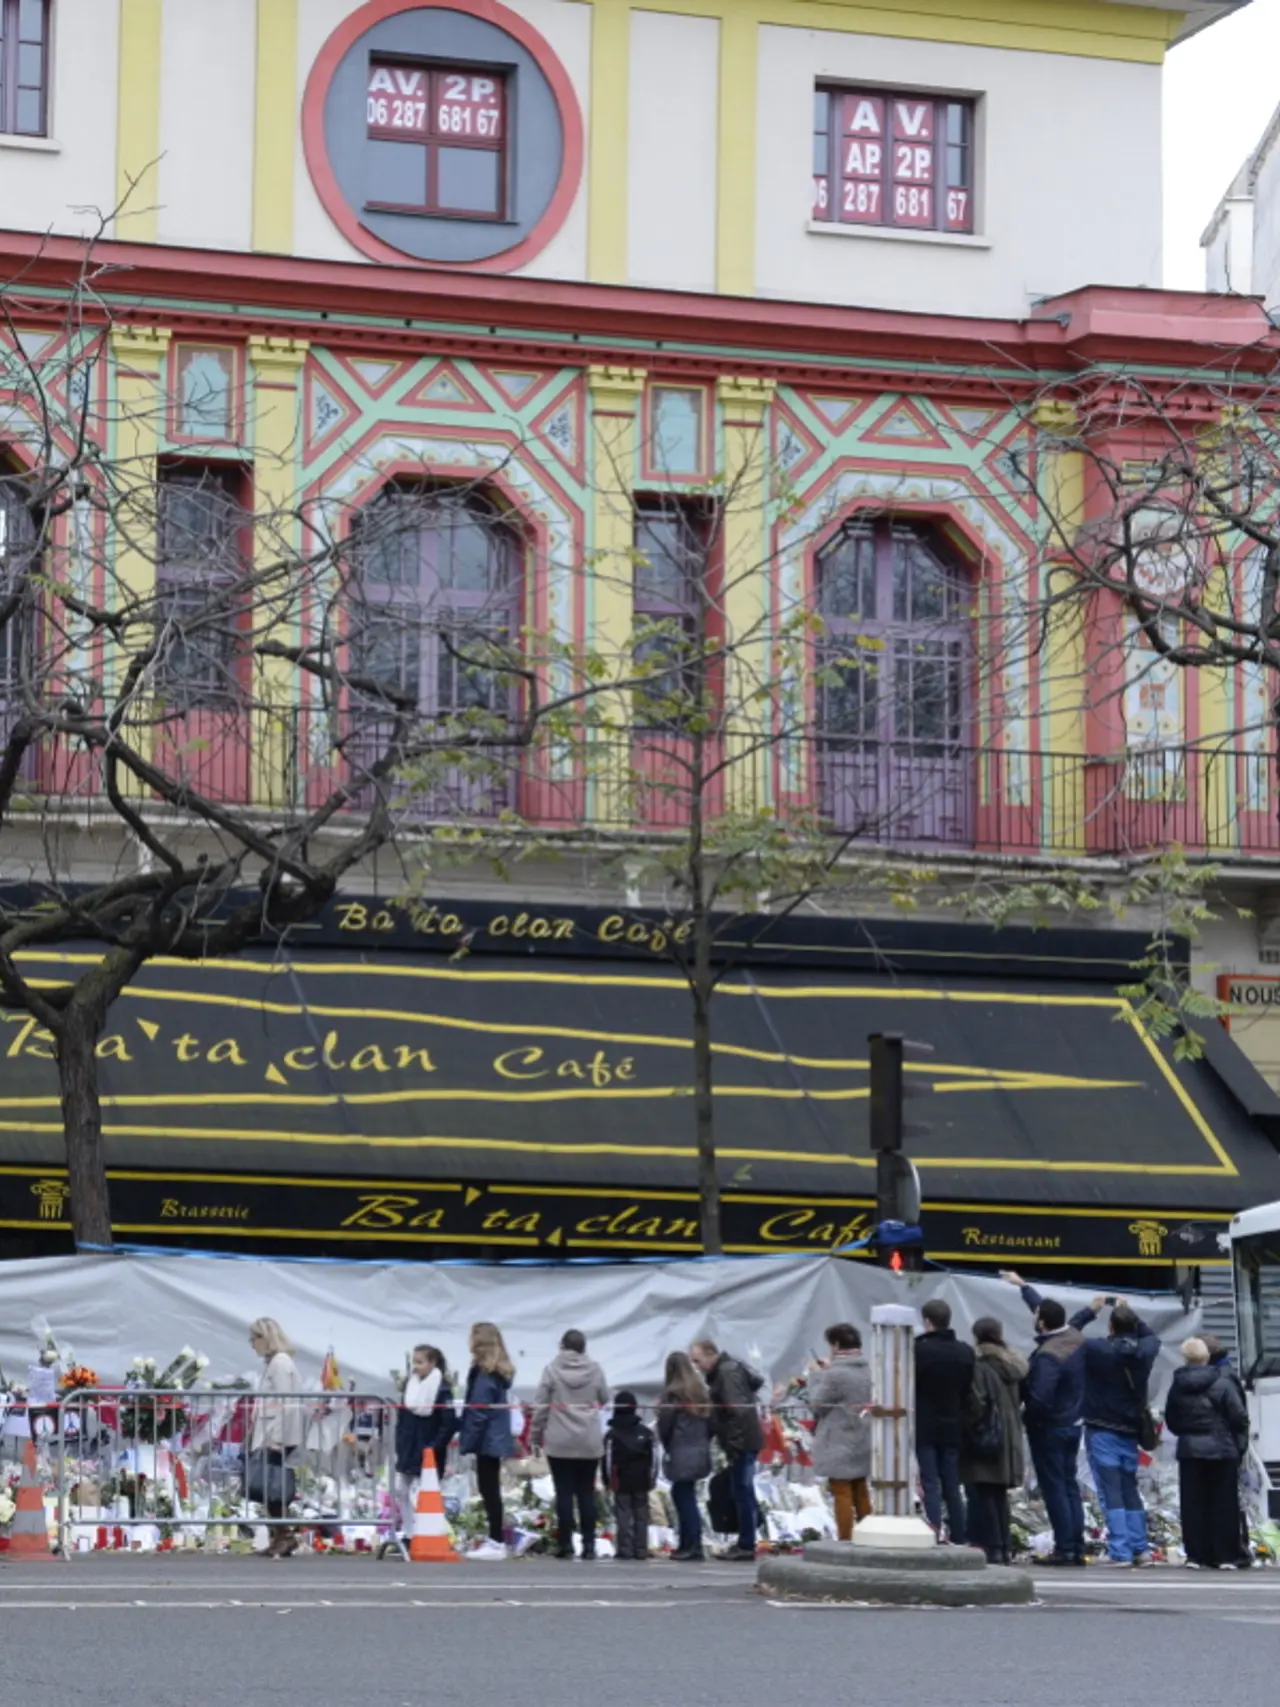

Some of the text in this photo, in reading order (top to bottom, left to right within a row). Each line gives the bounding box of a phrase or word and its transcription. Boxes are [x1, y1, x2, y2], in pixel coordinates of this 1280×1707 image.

[367, 97, 500, 136] 06 287 681 67
[843, 182, 880, 213] 287
[895, 186, 929, 218] 681
[947, 191, 967, 221] 67
[493, 1045, 637, 1088] Café
[161, 1198, 250, 1219] Brasserie
[962, 1227, 1061, 1248] Restaurant
